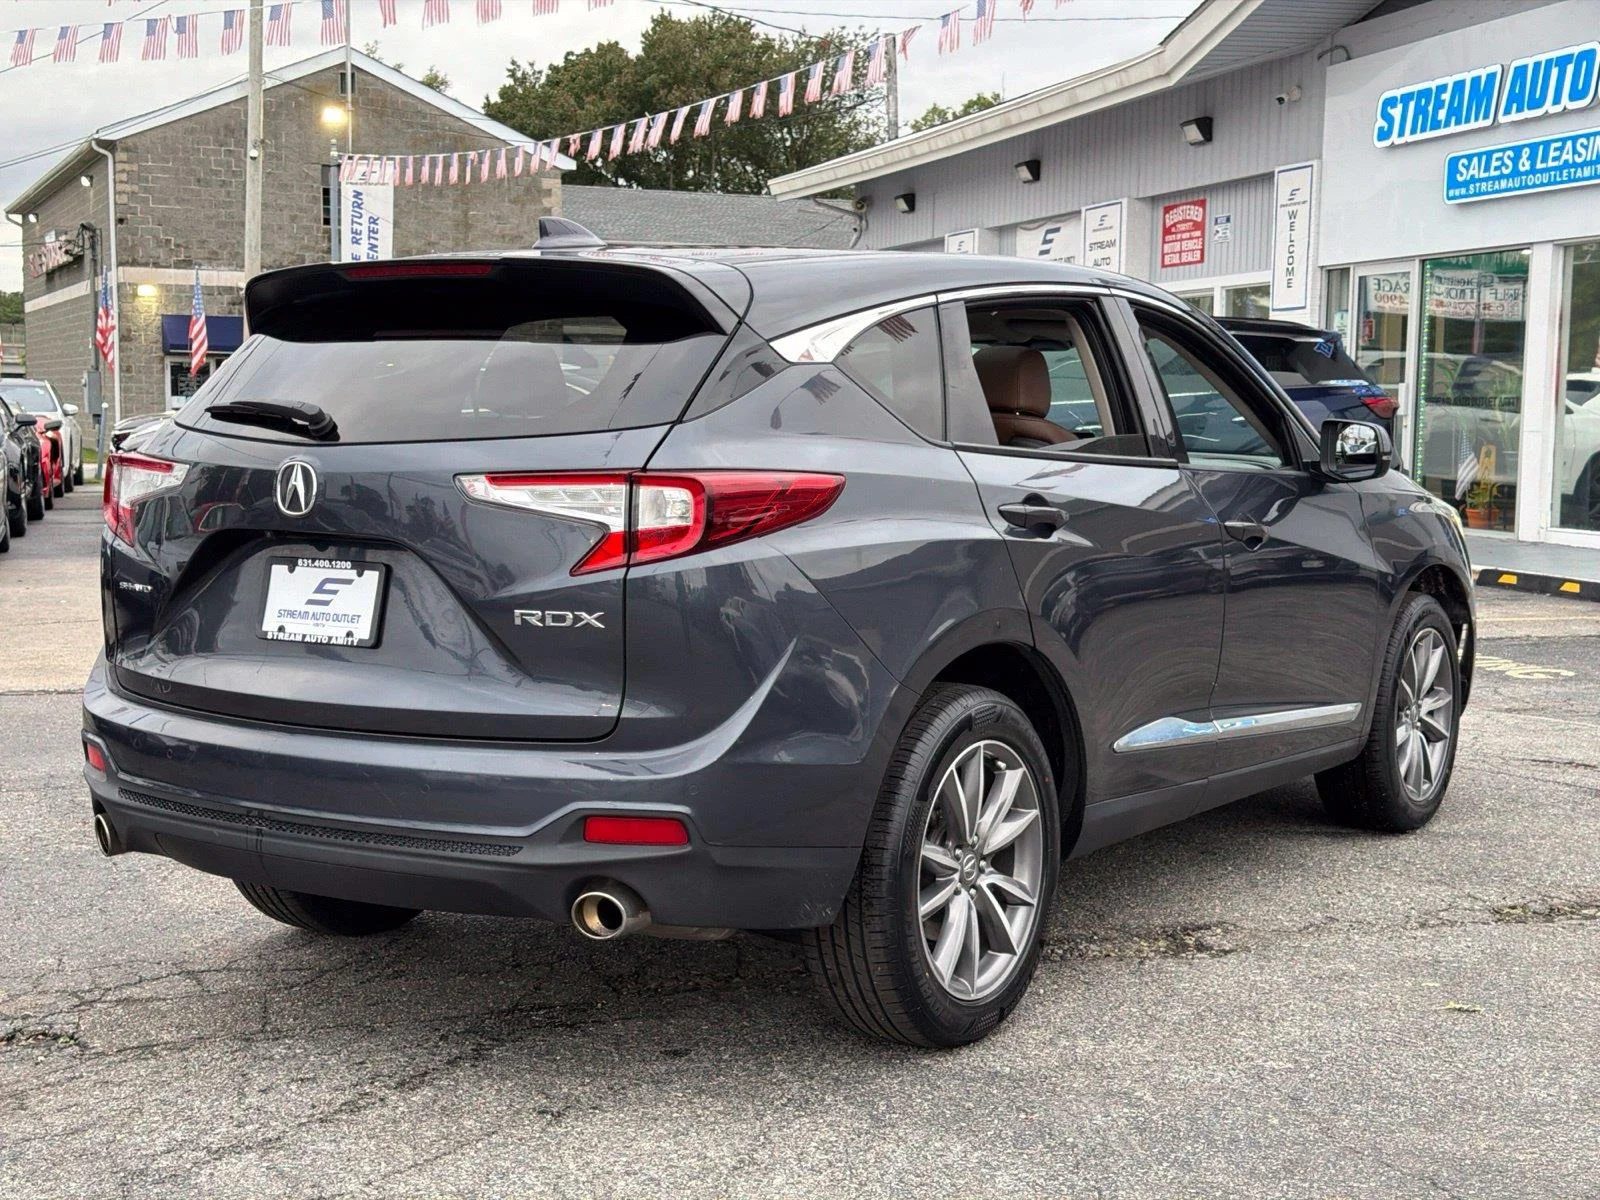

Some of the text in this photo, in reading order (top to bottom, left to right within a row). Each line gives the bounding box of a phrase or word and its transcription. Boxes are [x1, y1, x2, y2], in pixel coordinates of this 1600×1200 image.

[1375, 48, 1598, 143] STREAM AUTO
[1456, 150, 1515, 182] SALES
[1518, 147, 1531, 172] &
[351, 189, 364, 245] RETURN
[1164, 205, 1203, 228] REGISTERED
[1088, 239, 1116, 252] STREAM
[1181, 237, 1203, 251] VEHICLE
[1285, 209, 1298, 288] WELCOME
[1093, 257, 1111, 267] AUTO
[1181, 249, 1201, 263] DEALER
[297, 559, 352, 569] 631.400.1200
[277, 608, 361, 624] STREAM AUTO OUTLET
[513, 609, 605, 629] RDX
[266, 631, 360, 646] STREAM AUTO AMITY
